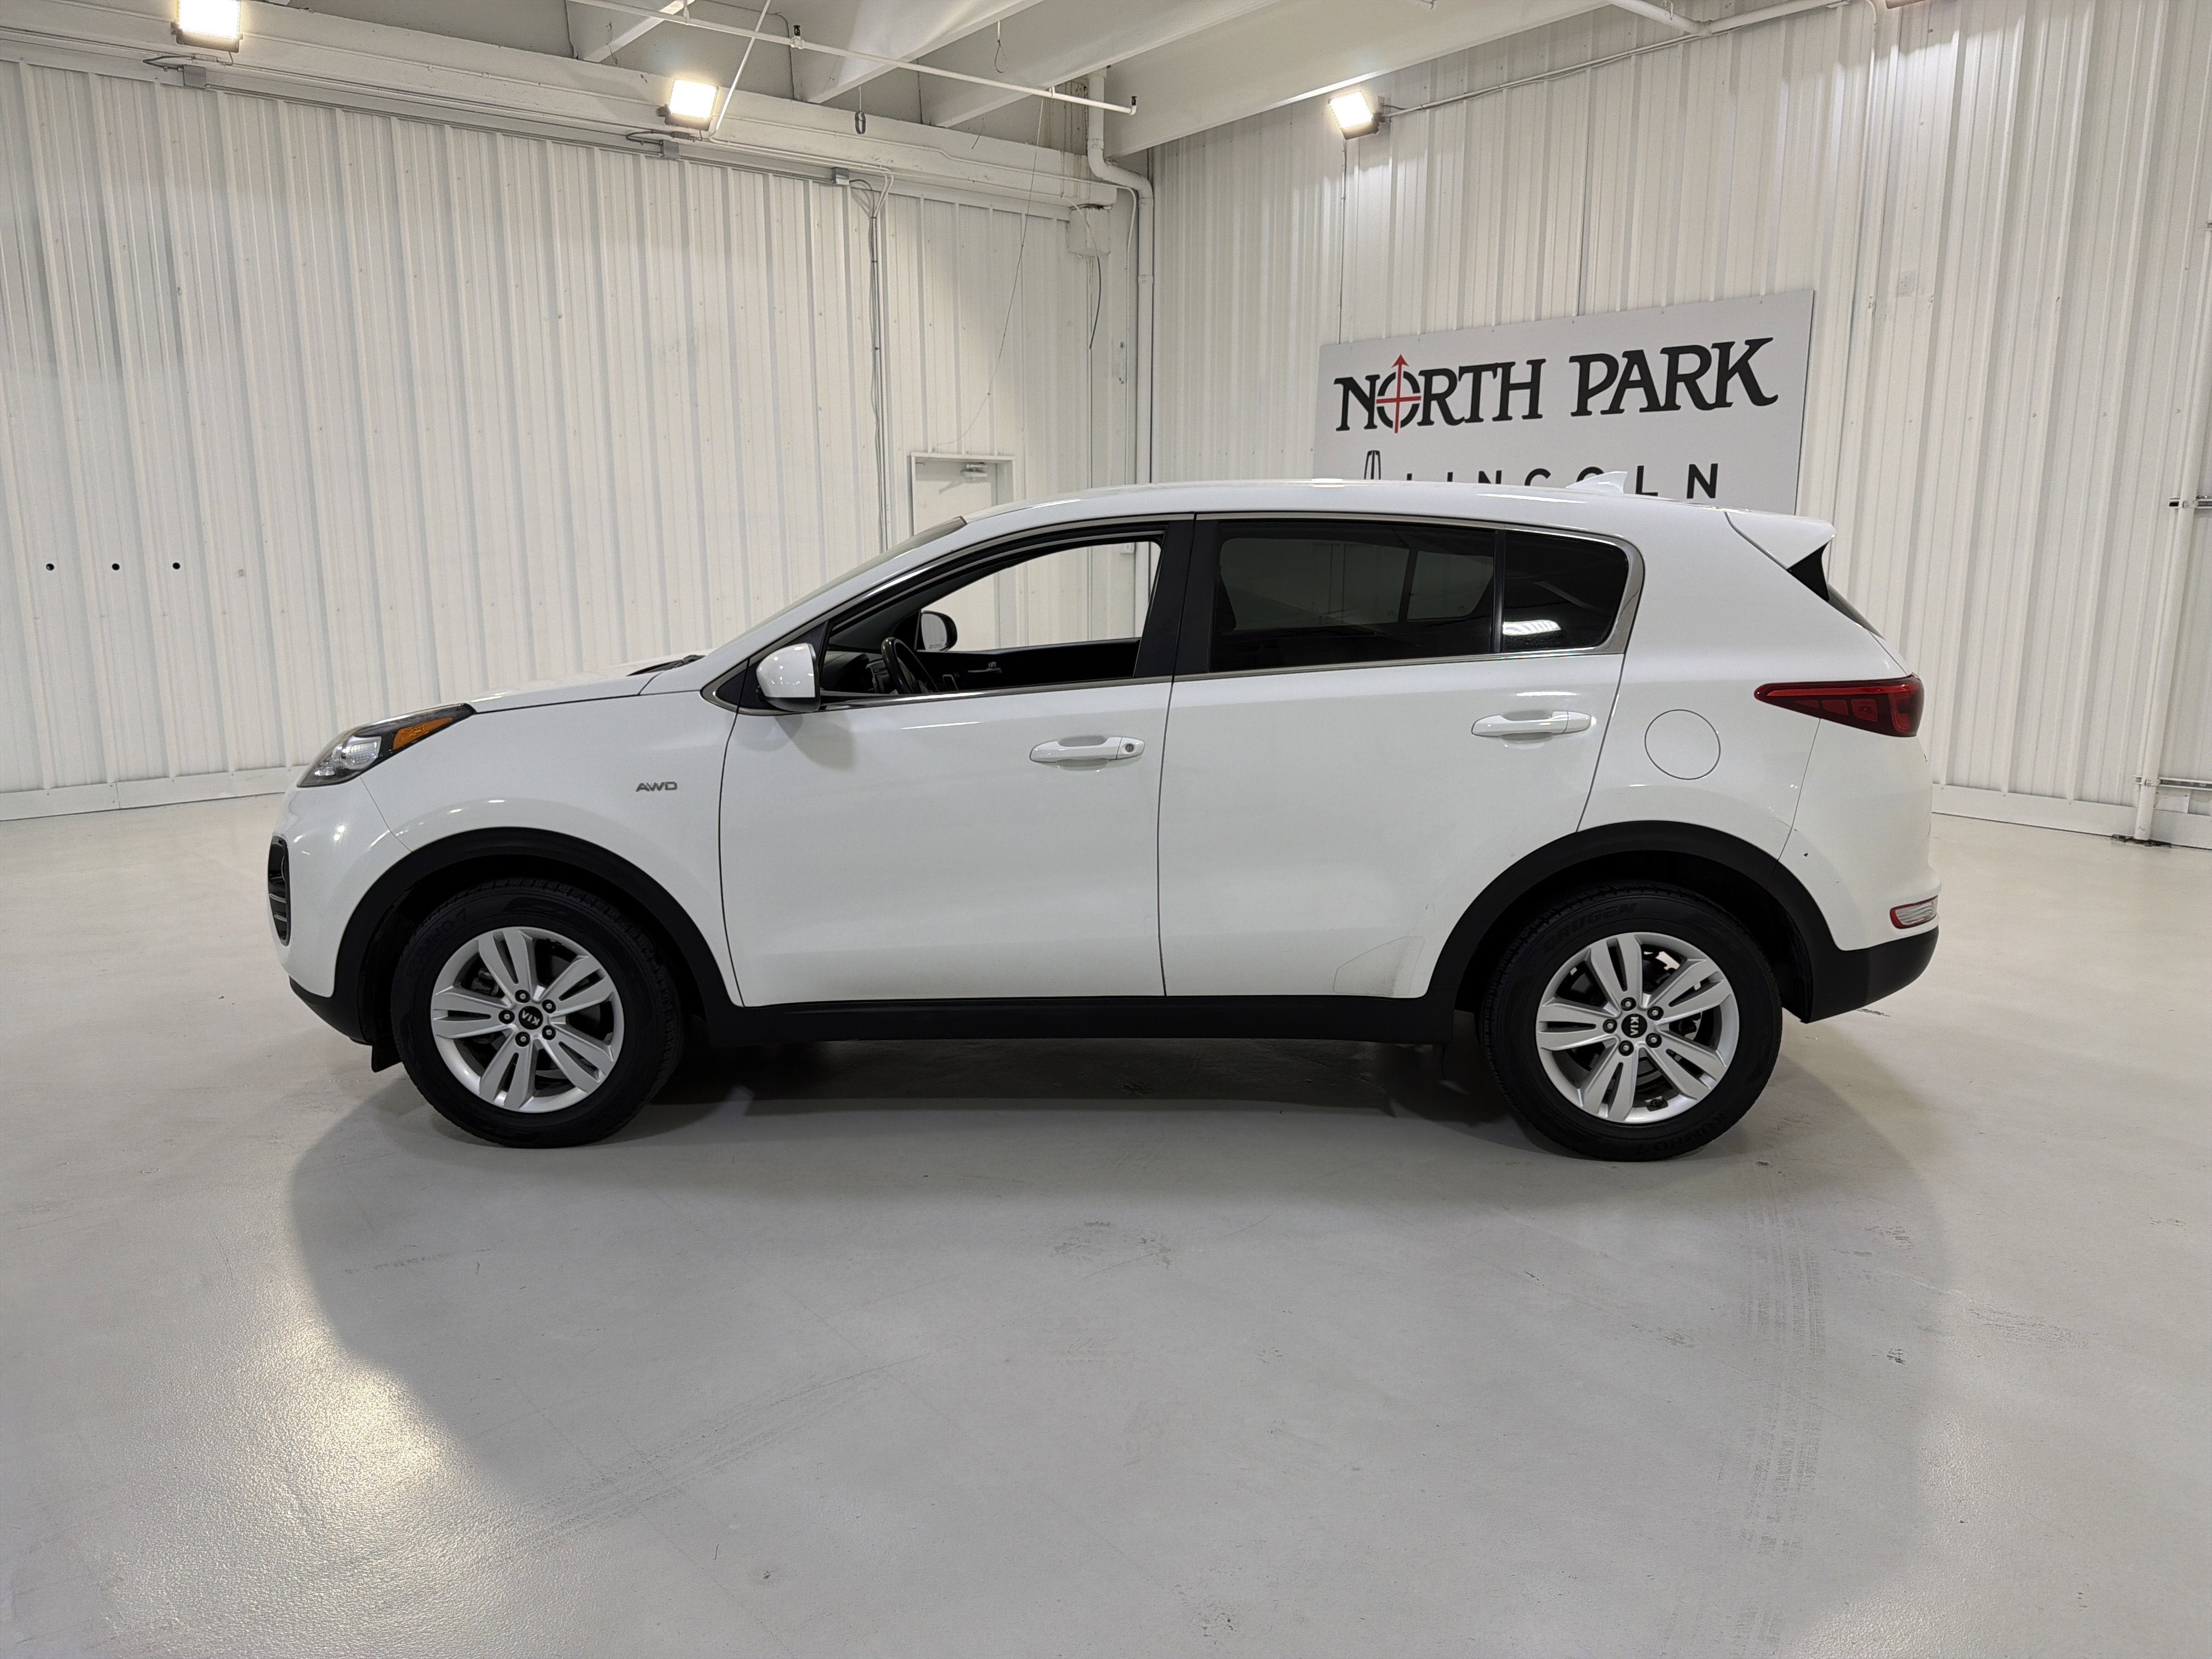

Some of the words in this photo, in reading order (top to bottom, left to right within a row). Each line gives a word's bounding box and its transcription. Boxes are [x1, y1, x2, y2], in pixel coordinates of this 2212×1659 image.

[1334, 358, 1547, 432] NORTH
[1568, 337, 1778, 417] PARK
[1406, 463, 1718, 499] NCLN
[635, 781, 678, 792] AWD
[522, 1010, 540, 1025] KIA
[1630, 1017, 1639, 1035] KIA
